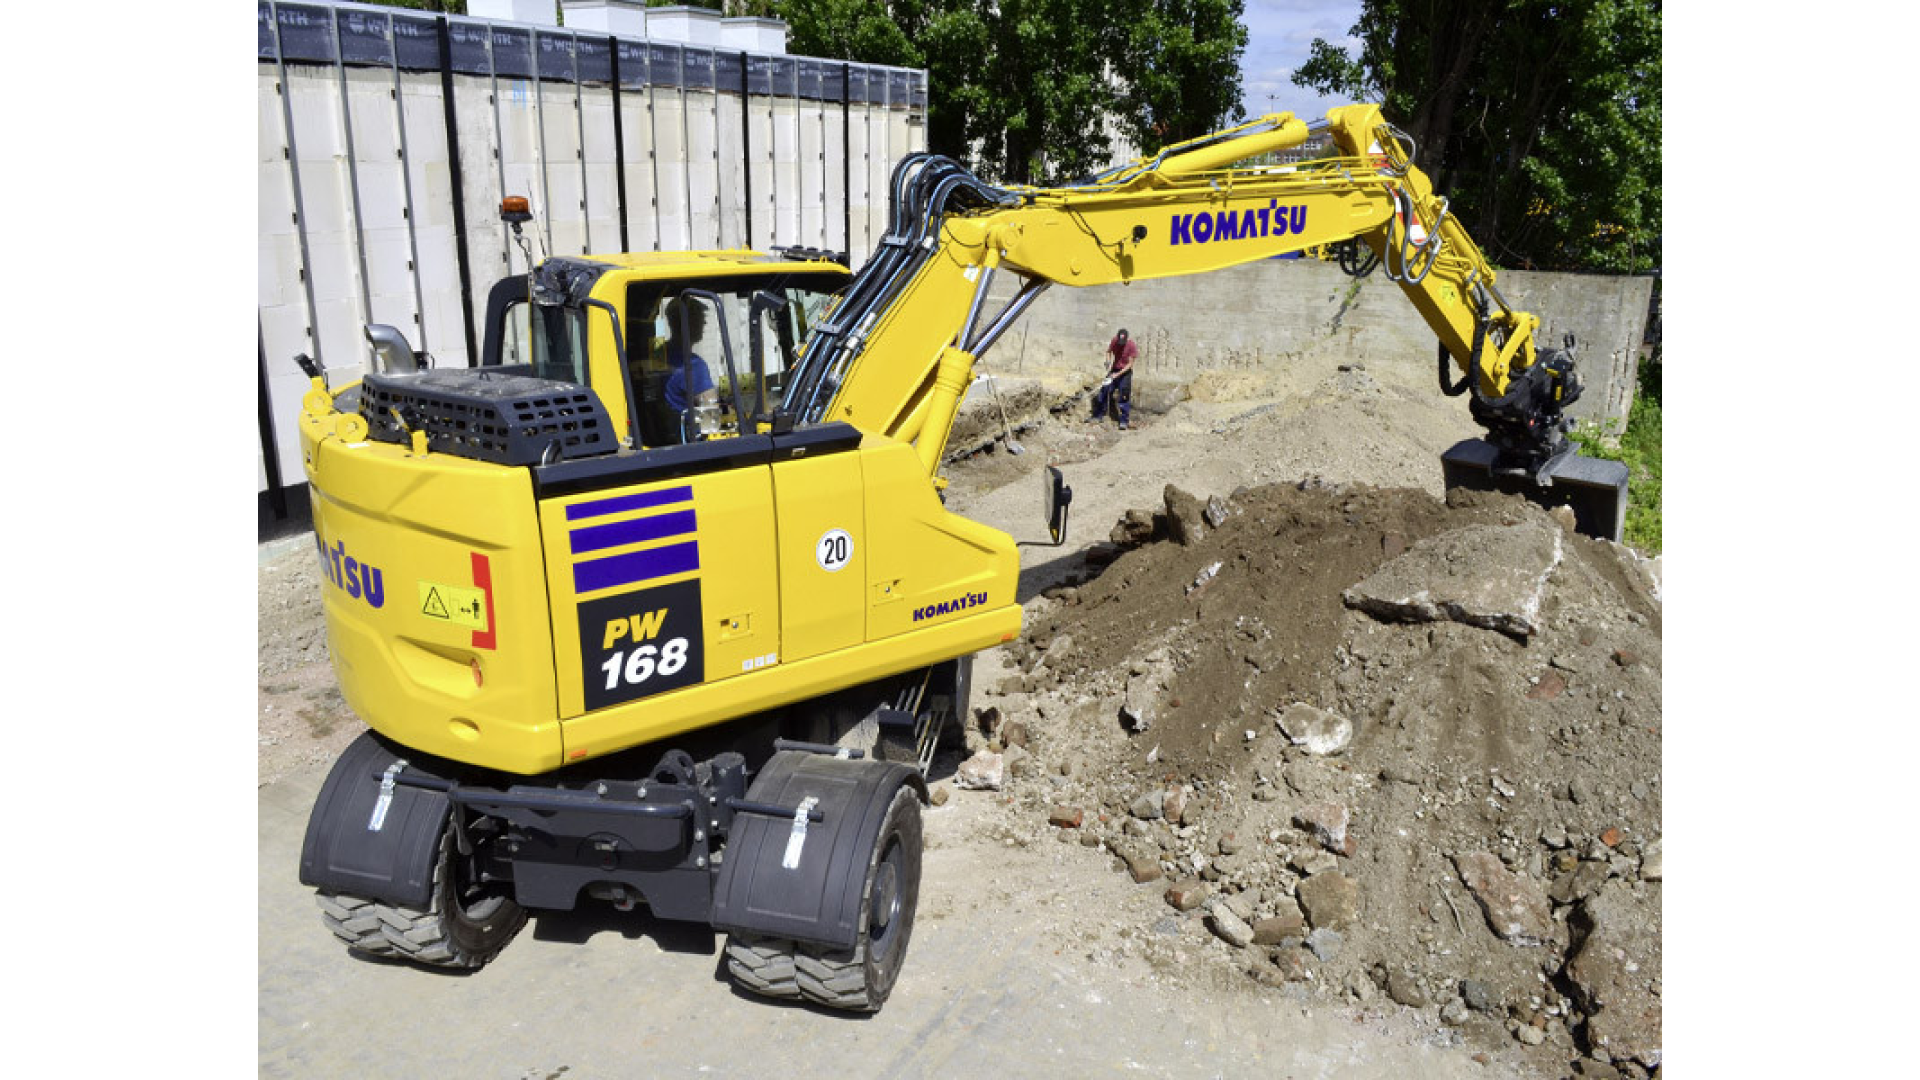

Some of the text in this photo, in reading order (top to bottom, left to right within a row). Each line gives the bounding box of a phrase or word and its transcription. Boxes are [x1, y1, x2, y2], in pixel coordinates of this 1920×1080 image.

[1170, 198, 1308, 245] KOMATSU
[316, 533, 385, 609] ATSU
[824, 536, 847, 564] 20
[912, 592, 988, 621] KOMATSU
[603, 608, 669, 650] PW
[601, 636, 690, 690] 168
